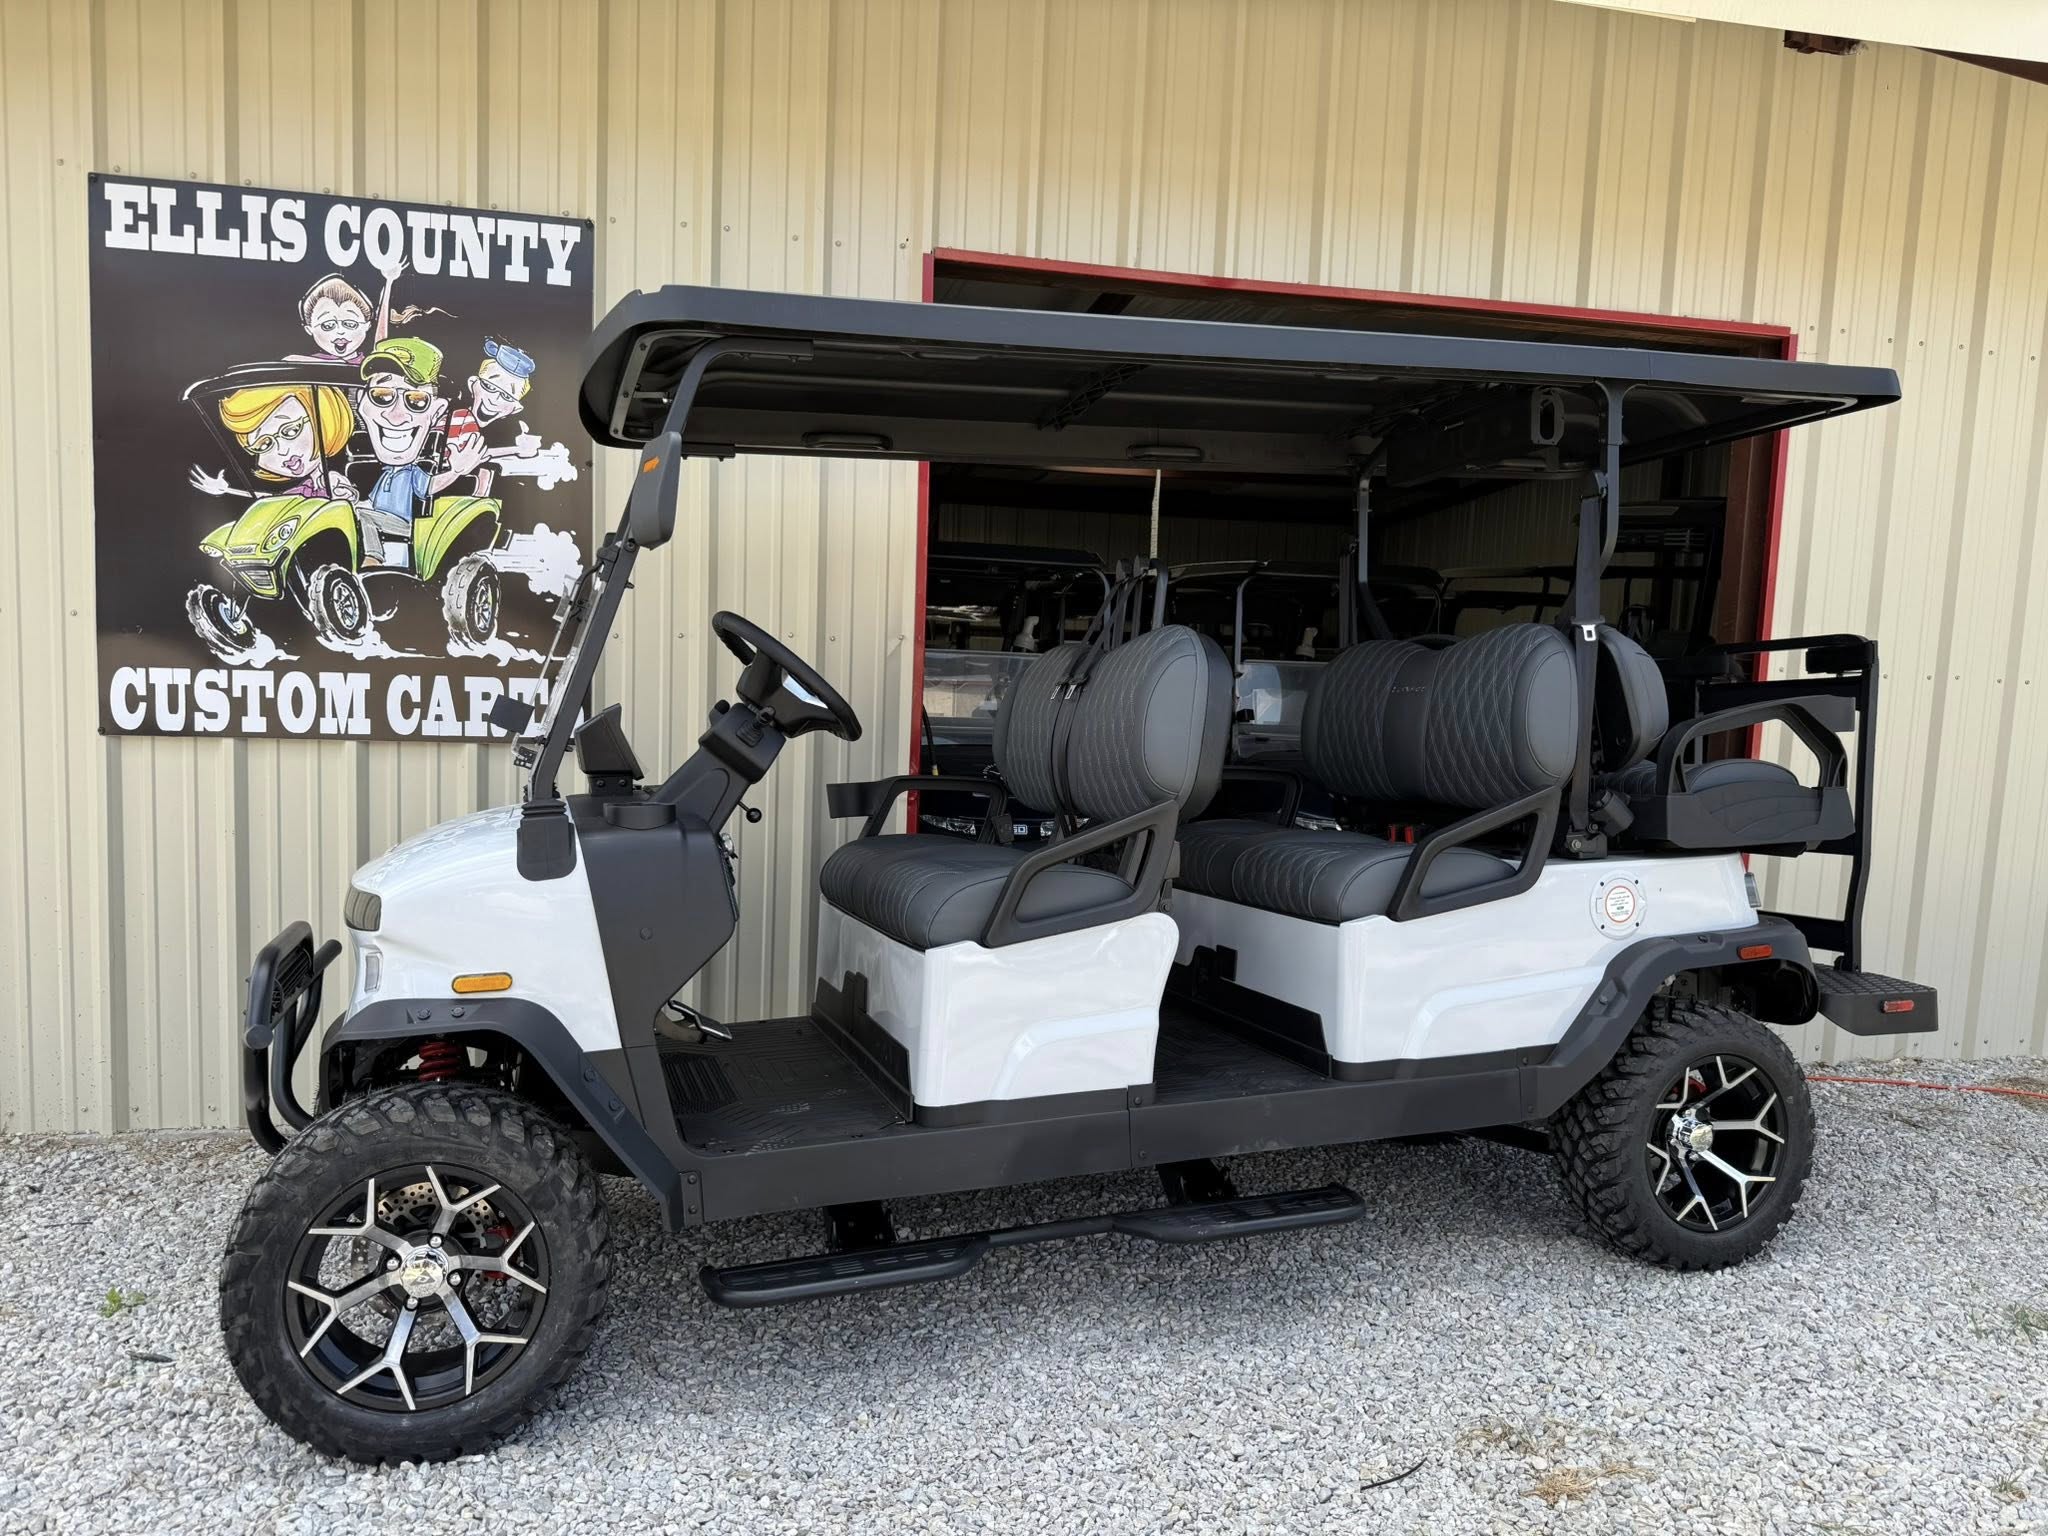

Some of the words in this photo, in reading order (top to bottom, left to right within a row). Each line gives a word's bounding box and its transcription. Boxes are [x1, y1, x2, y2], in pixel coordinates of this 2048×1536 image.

[104, 182, 308, 263] ELLIS
[324, 203, 582, 287] COUNTY
[109, 666, 371, 735] CUSTOM
[386, 674, 584, 739] CART
